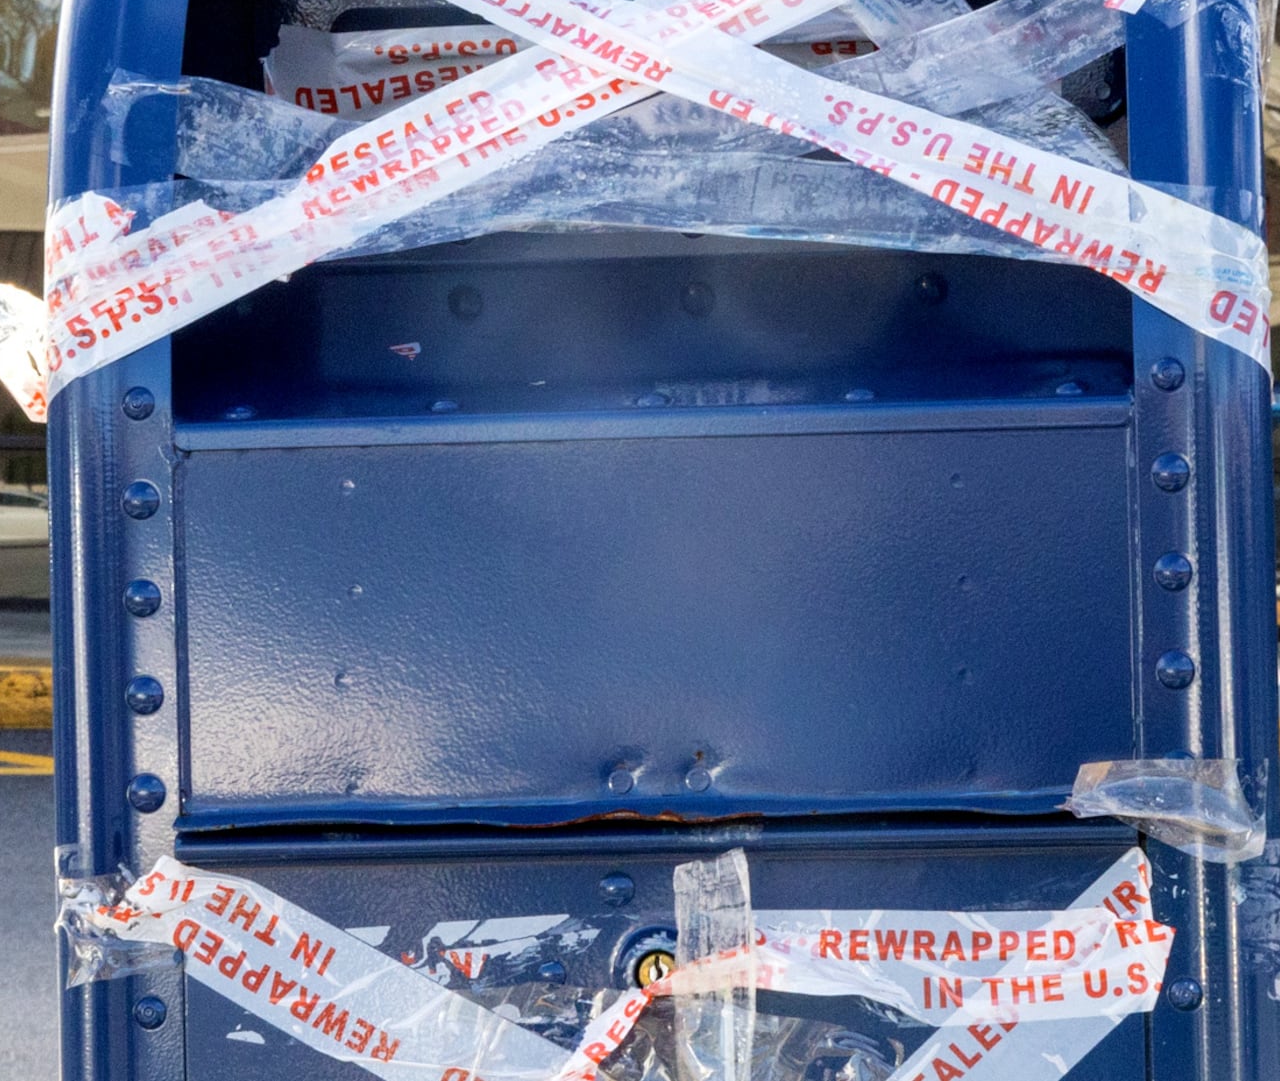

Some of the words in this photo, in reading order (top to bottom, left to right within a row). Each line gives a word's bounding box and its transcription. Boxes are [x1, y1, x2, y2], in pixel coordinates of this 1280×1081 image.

[374, 38, 518, 65] U.S.P.S.
[305, 89, 494, 186] RESEALED
[823, 93, 954, 163] U.S.P.S.
[962, 142, 1037, 195] THE
[1049, 174, 1096, 215] IN
[931, 178, 1167, 294] REWRAPPED
[204, 883, 281, 947] THE
[289, 930, 337, 977] IN
[820, 928, 1077, 962] REWRAPPED
[172, 918, 402, 1063] REWRAPPED
[922, 976, 965, 1009] IN
[981, 974, 1066, 1007] THE
